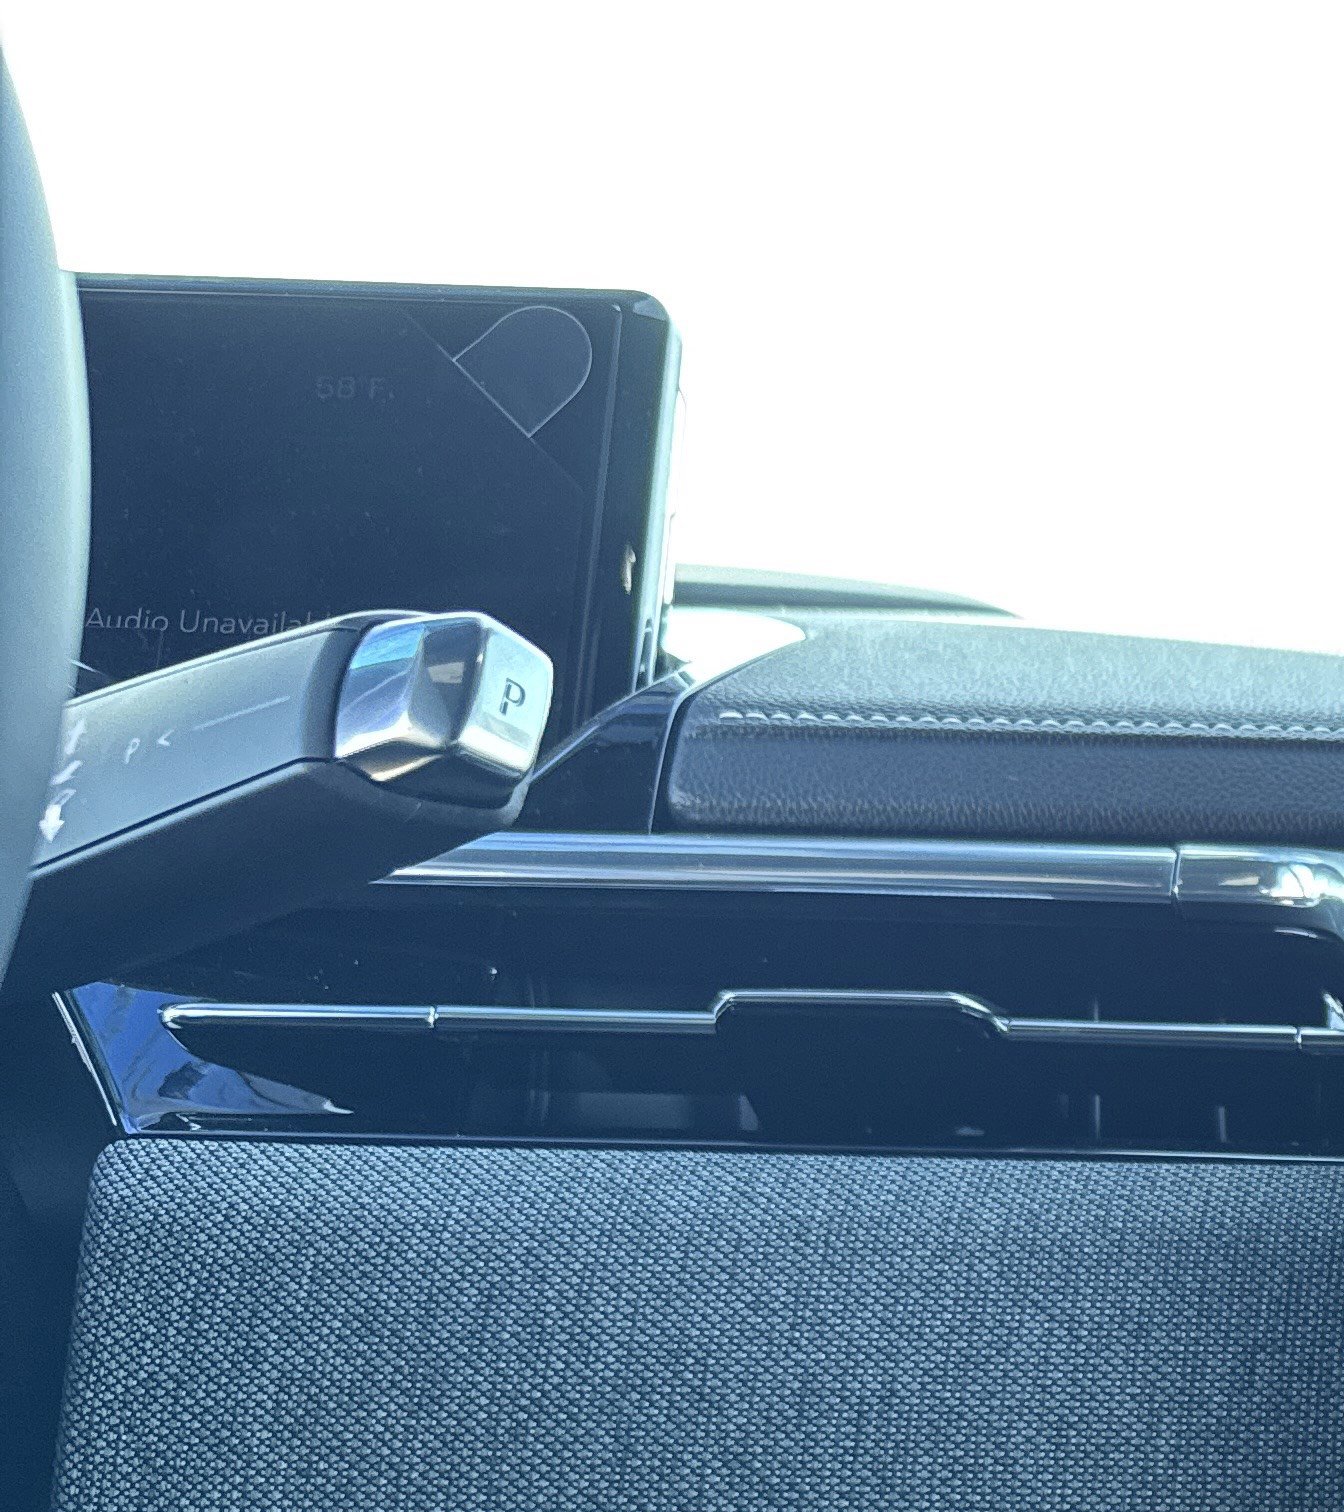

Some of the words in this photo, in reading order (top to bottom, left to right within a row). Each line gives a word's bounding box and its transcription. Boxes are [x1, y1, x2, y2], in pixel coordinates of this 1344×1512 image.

[85, 606, 170, 631] Audio
[179, 608, 331, 634] Unavaila
[500, 677, 526, 716] P
